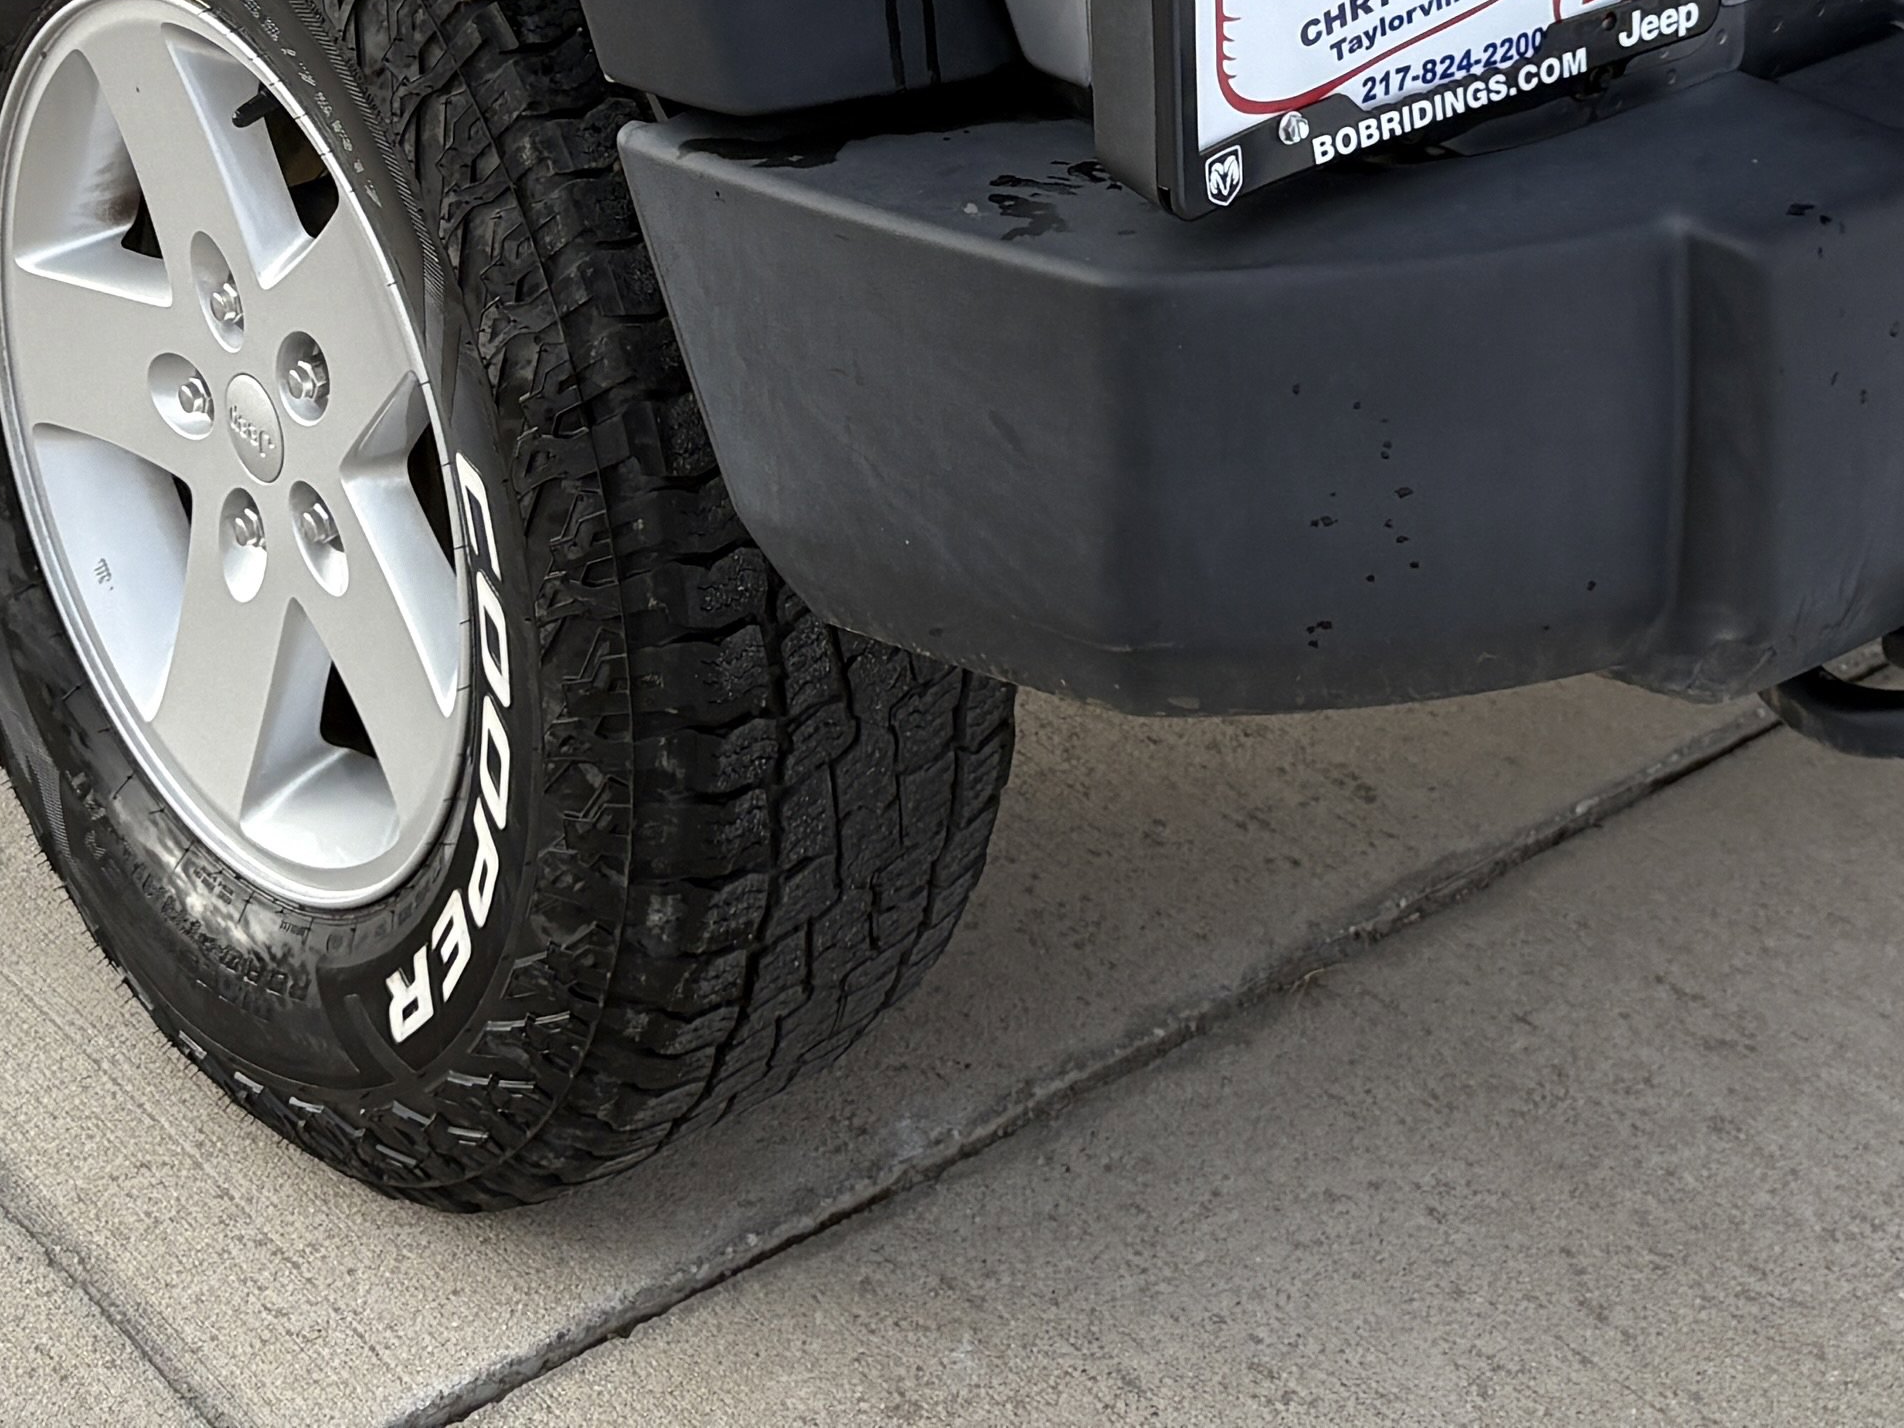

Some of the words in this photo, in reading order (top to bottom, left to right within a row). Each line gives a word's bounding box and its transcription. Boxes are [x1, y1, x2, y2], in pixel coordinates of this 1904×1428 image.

[1361, 26, 1547, 104] 217-824-2200
[1617, 1, 1700, 48] Jeep
[1311, 46, 1588, 165] BOBRIDINGS.COM
[386, 451, 511, 1043] COOPER
